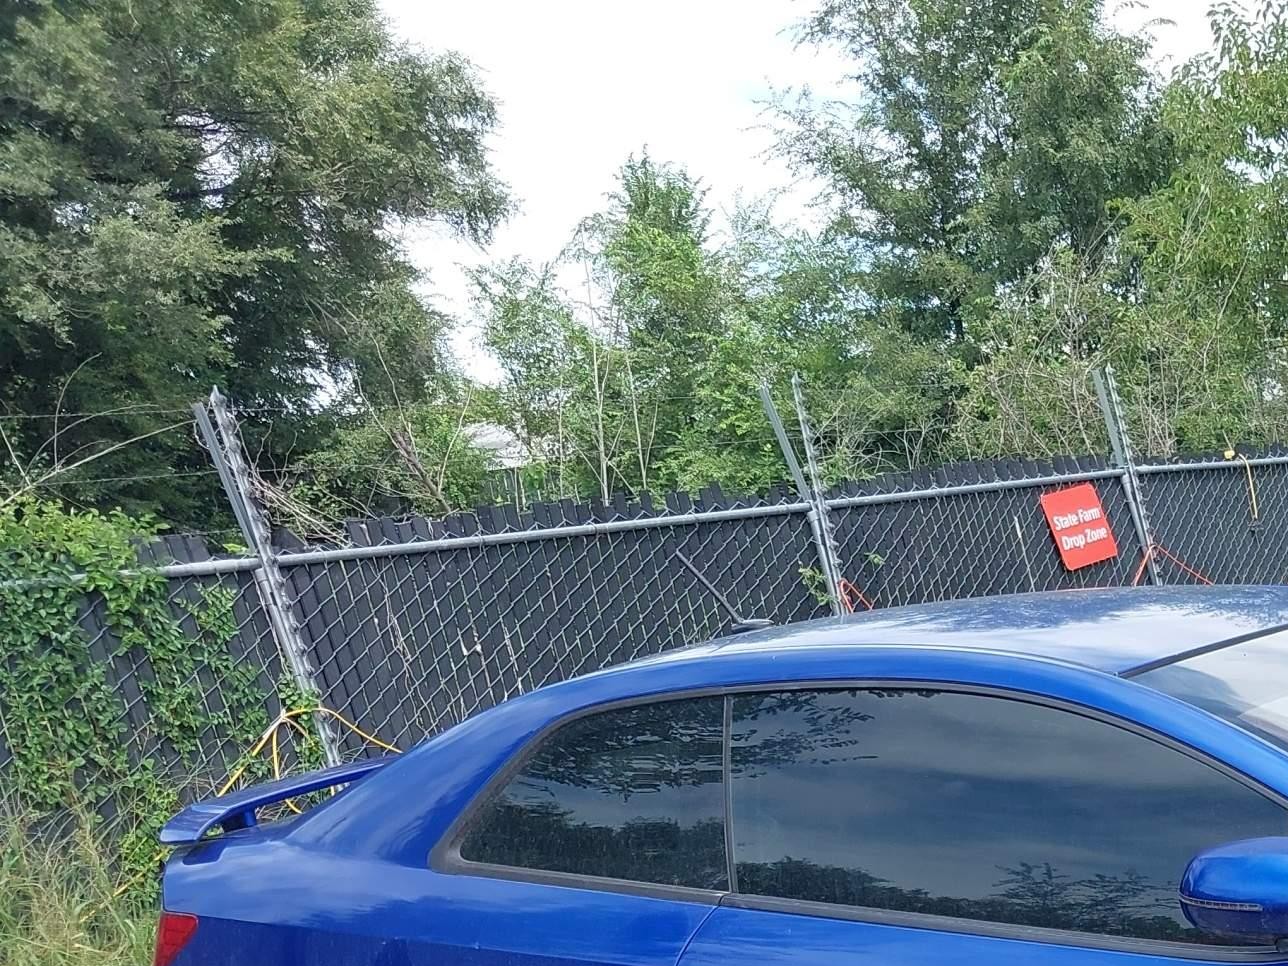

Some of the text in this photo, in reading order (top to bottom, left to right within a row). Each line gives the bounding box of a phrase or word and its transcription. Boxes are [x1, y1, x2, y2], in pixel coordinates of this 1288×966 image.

[1053, 508, 1101, 530] State Farm
[1061, 528, 1107, 551] Drop Zone
